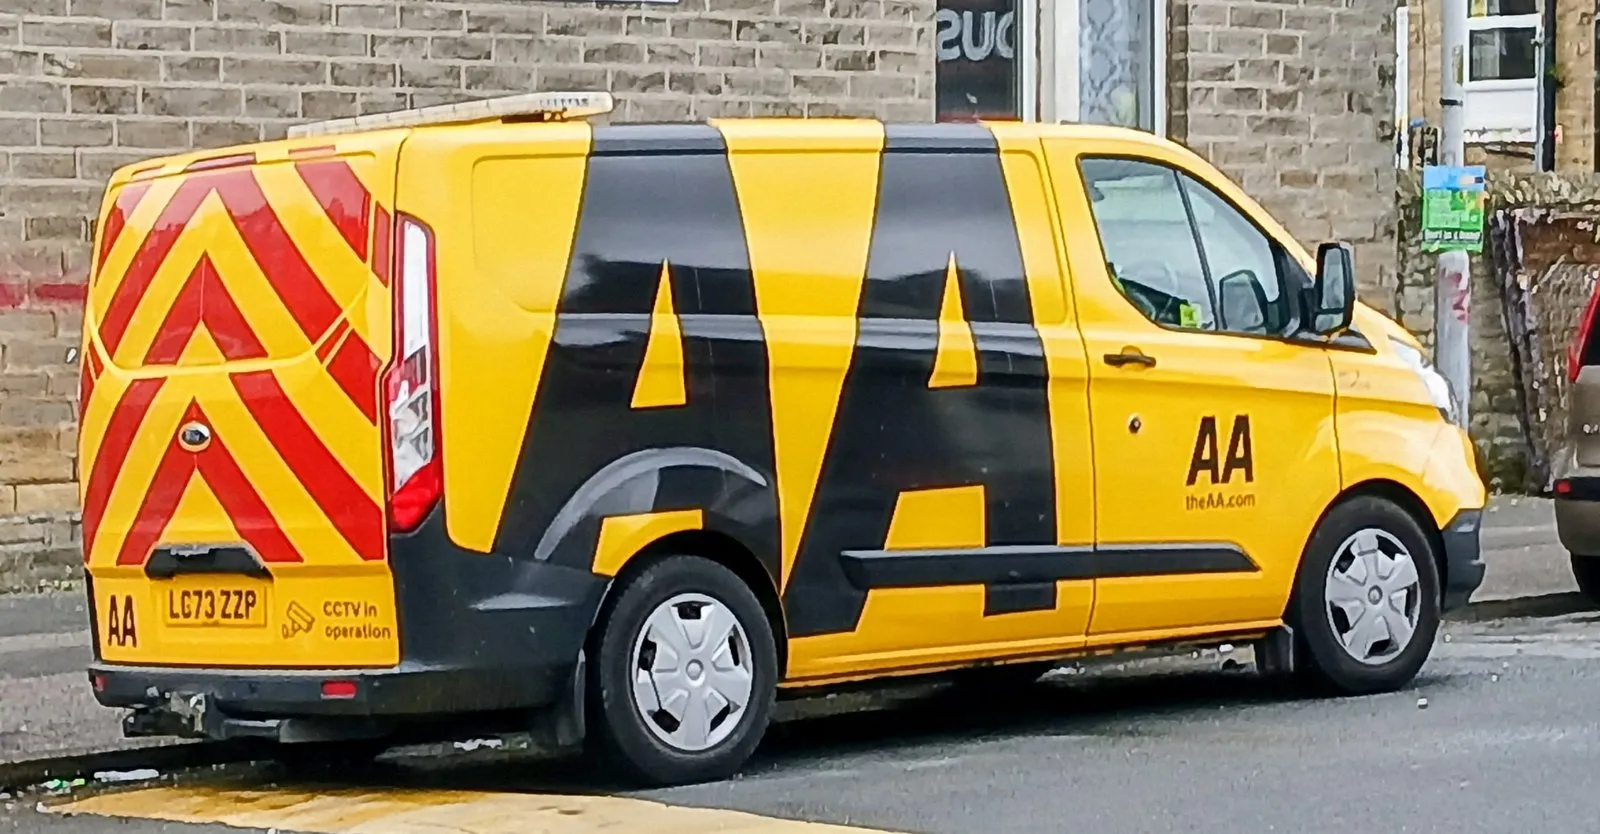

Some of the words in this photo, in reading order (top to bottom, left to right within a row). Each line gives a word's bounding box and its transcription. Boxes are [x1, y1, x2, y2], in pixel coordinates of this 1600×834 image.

[492, 121, 1058, 636] AA
[1186, 414, 1254, 486] AA
[1185, 492, 1256, 511] theAA.com
[168, 588, 217, 620] LG73
[220, 589, 257, 619] ZZP
[322, 600, 361, 617] CCTV
[364, 601, 378, 617] in
[107, 594, 138, 648] AA
[324, 622, 392, 641] operation
